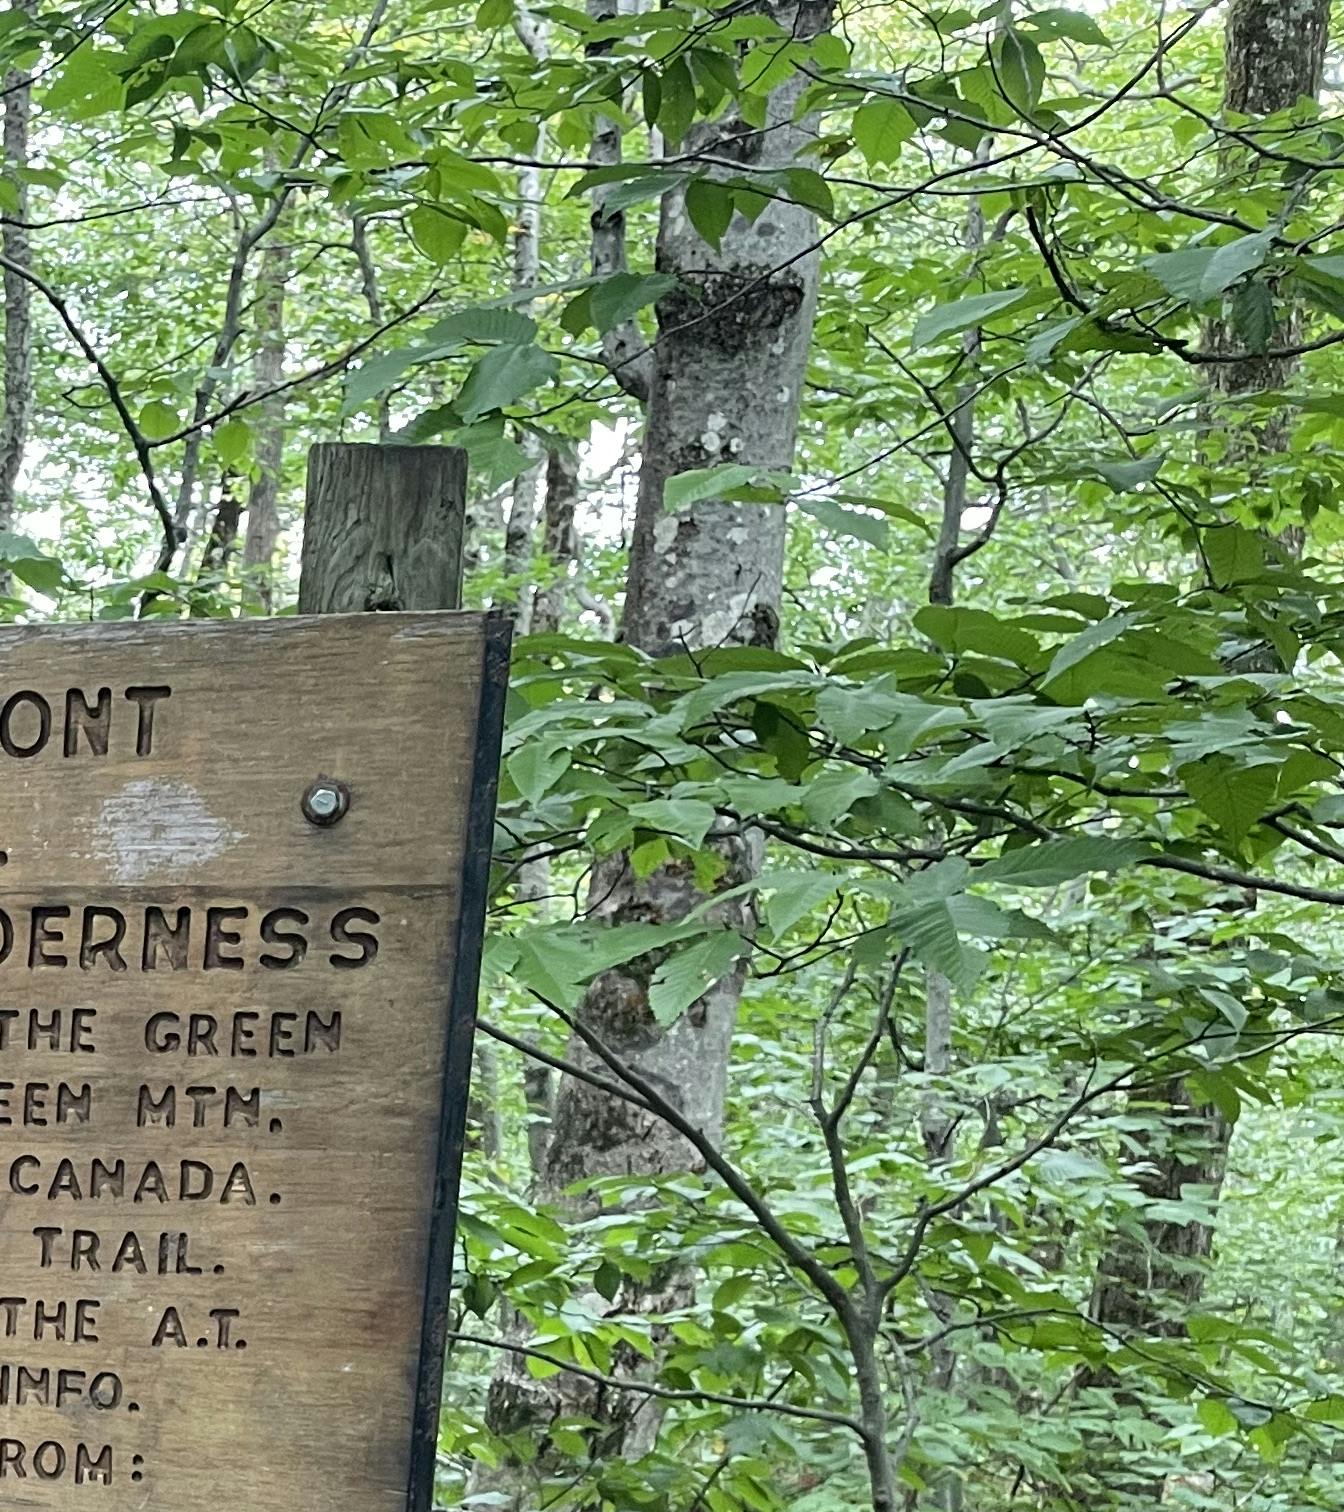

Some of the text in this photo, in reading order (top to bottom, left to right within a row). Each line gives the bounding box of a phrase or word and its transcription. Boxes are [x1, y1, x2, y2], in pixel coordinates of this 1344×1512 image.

[144, 1010, 342, 1057] GREEN
[136, 1084, 284, 1134] MTN.
[9, 1153, 281, 1202] CANADA.
[32, 1226, 226, 1276] TRAIL.
[151, 1306, 248, 1350] A.T.
